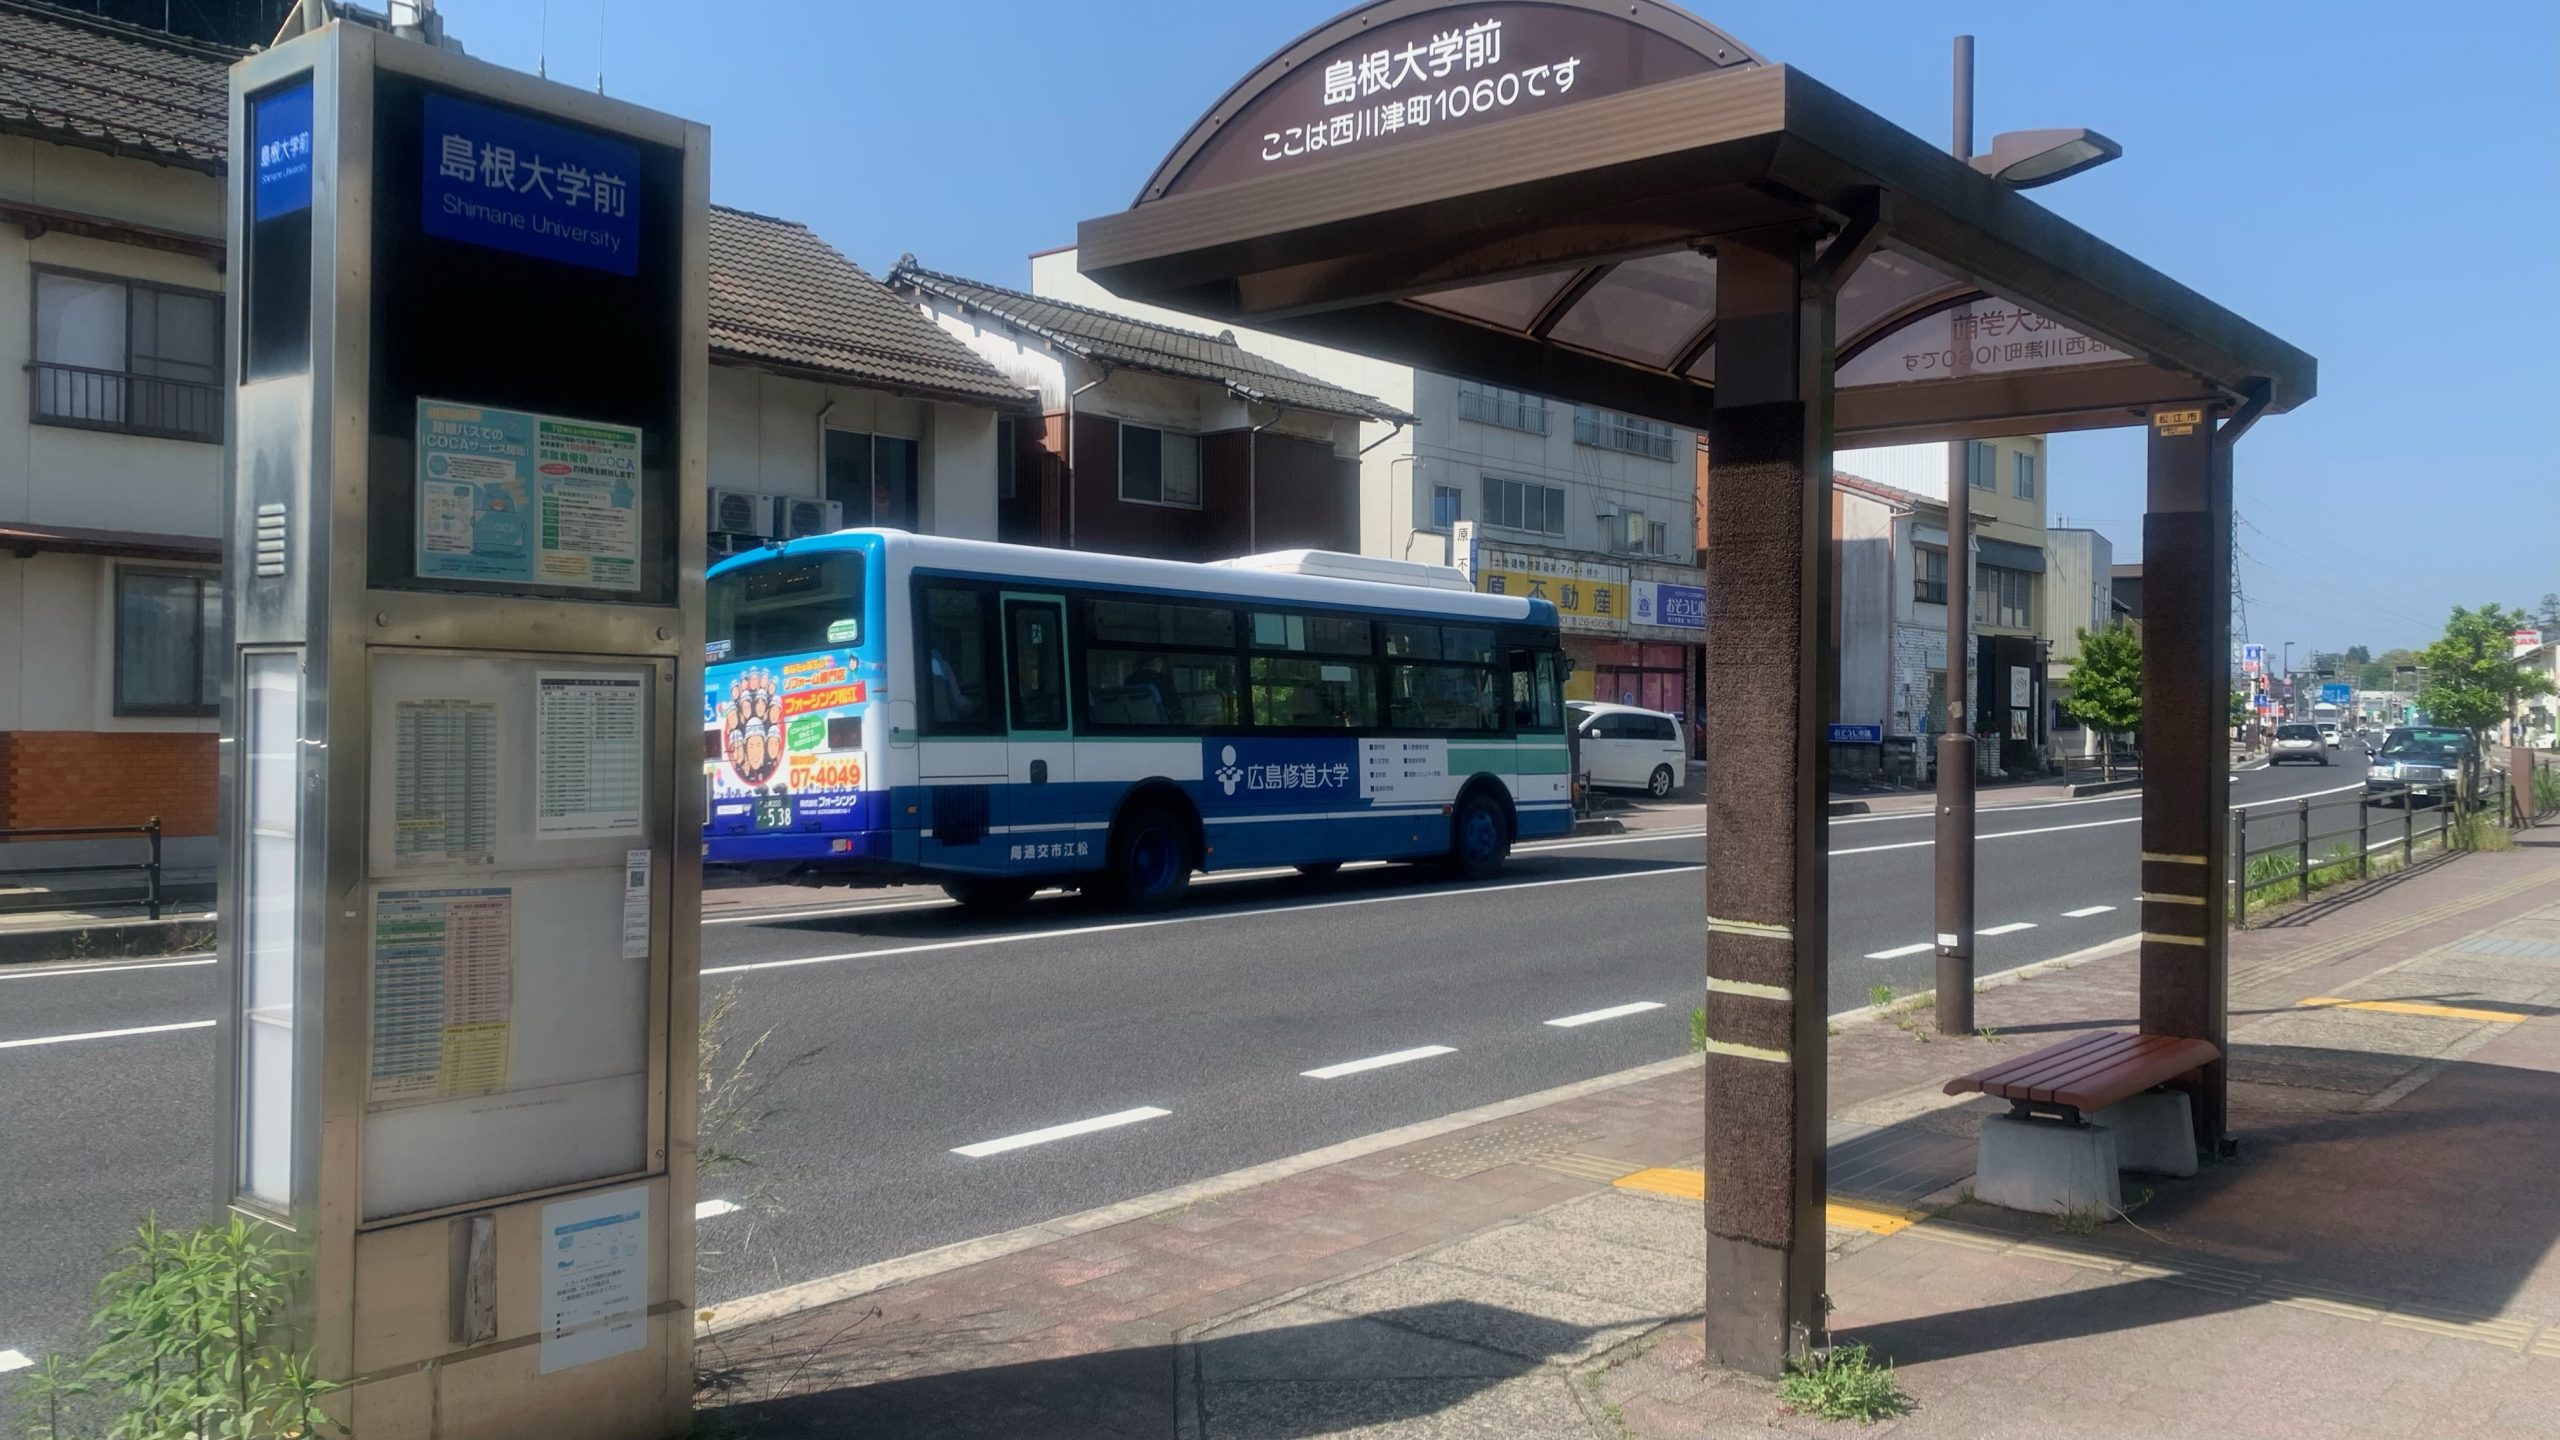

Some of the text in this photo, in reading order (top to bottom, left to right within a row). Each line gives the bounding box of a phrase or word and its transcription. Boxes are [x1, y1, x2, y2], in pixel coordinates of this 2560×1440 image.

[1324, 18, 1502, 107] 島根大学前
[1261, 56, 1581, 162] ここは西川津町1060です
[439, 133, 627, 218] 島根大学前
[442, 194, 622, 254] Shimane University
[790, 764, 861, 789] 07-4049
[1247, 763, 1350, 790] 広島修道大学
